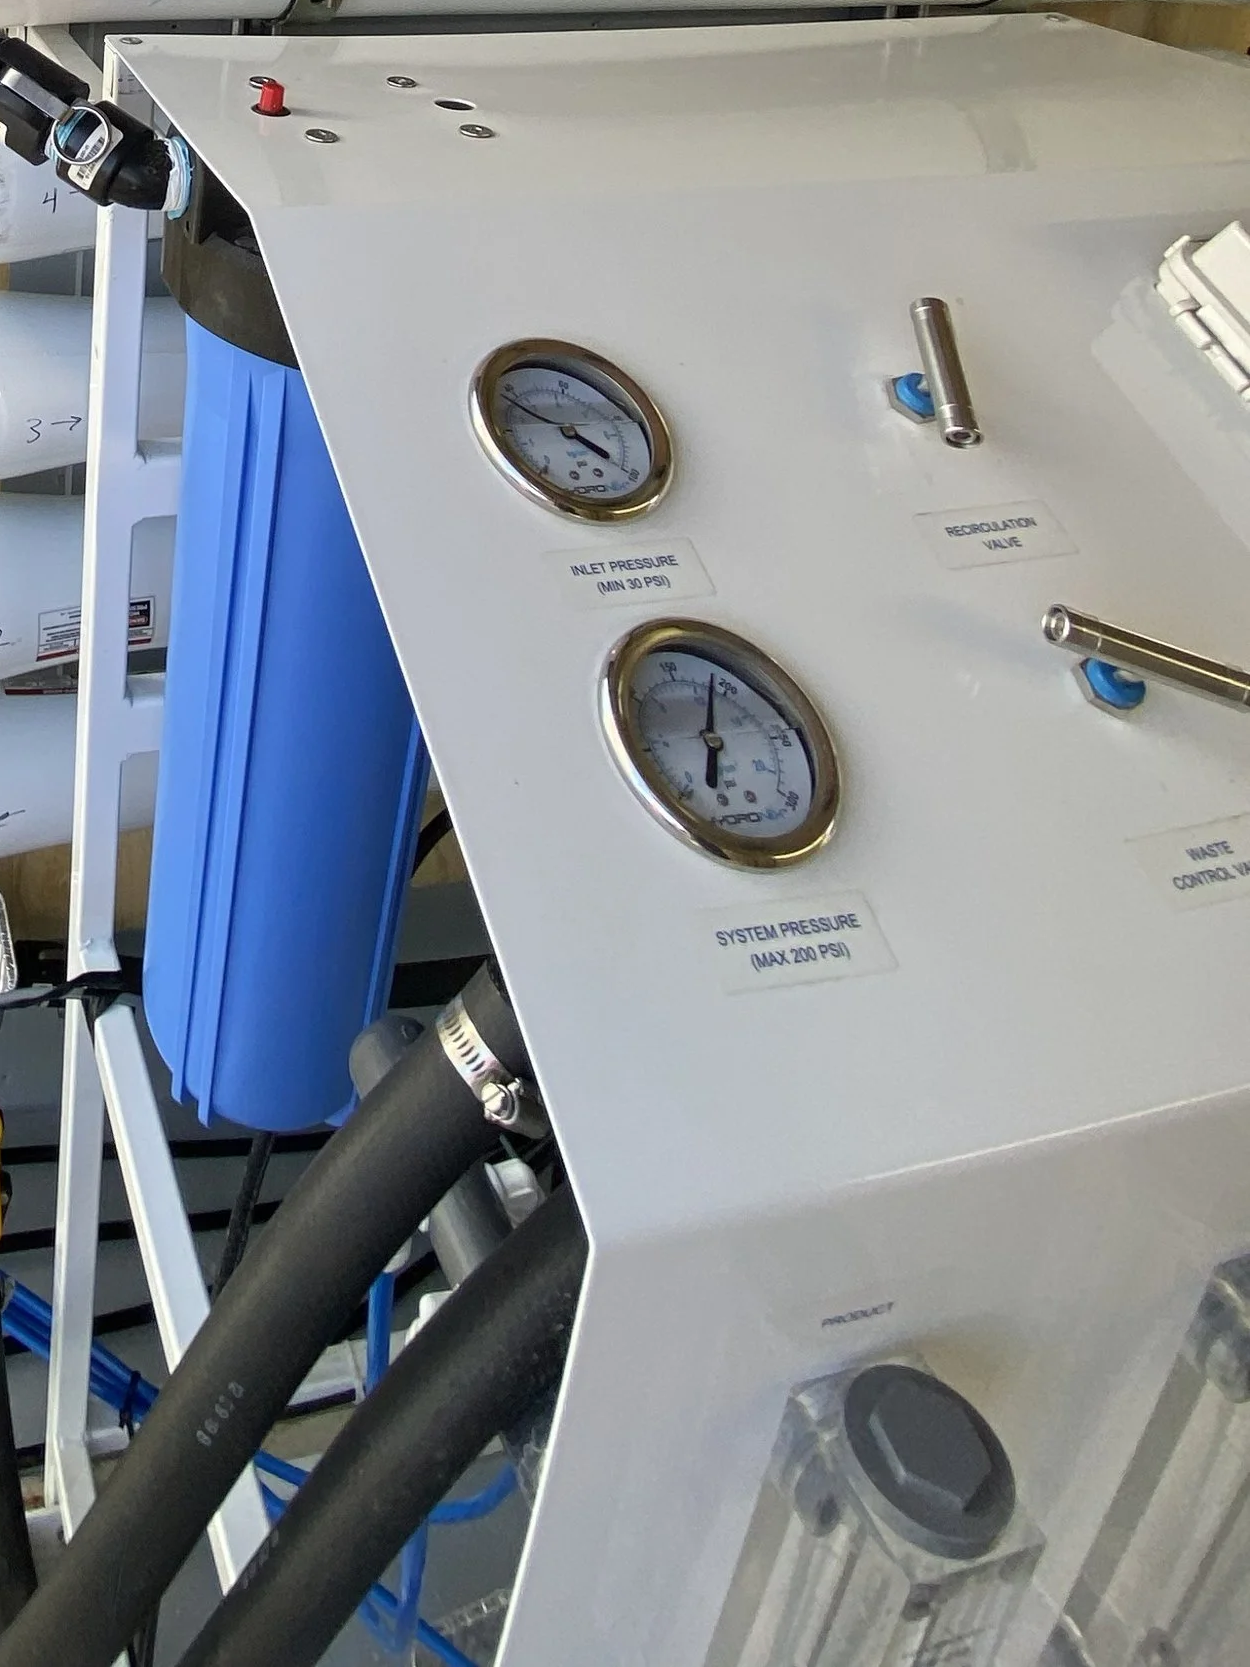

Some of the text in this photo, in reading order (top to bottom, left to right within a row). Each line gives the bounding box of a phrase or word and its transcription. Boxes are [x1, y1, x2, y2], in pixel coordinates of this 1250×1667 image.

[42, 187, 57, 213] 4
[26, 418, 42, 444] 3
[944, 517, 1038, 537] RECIRCULATION
[982, 536, 1023, 550] VALVE
[570, 554, 679, 576] INLET PRESSURE
[597, 574, 672, 596] (MIN 30 PSI)
[1185, 840, 1234, 861] WASTE
[1172, 867, 1236, 890] CONTROL
[715, 913, 862, 947] SYSTEM PRESSURE
[750, 941, 851, 972] (MAX 200 PSI)
